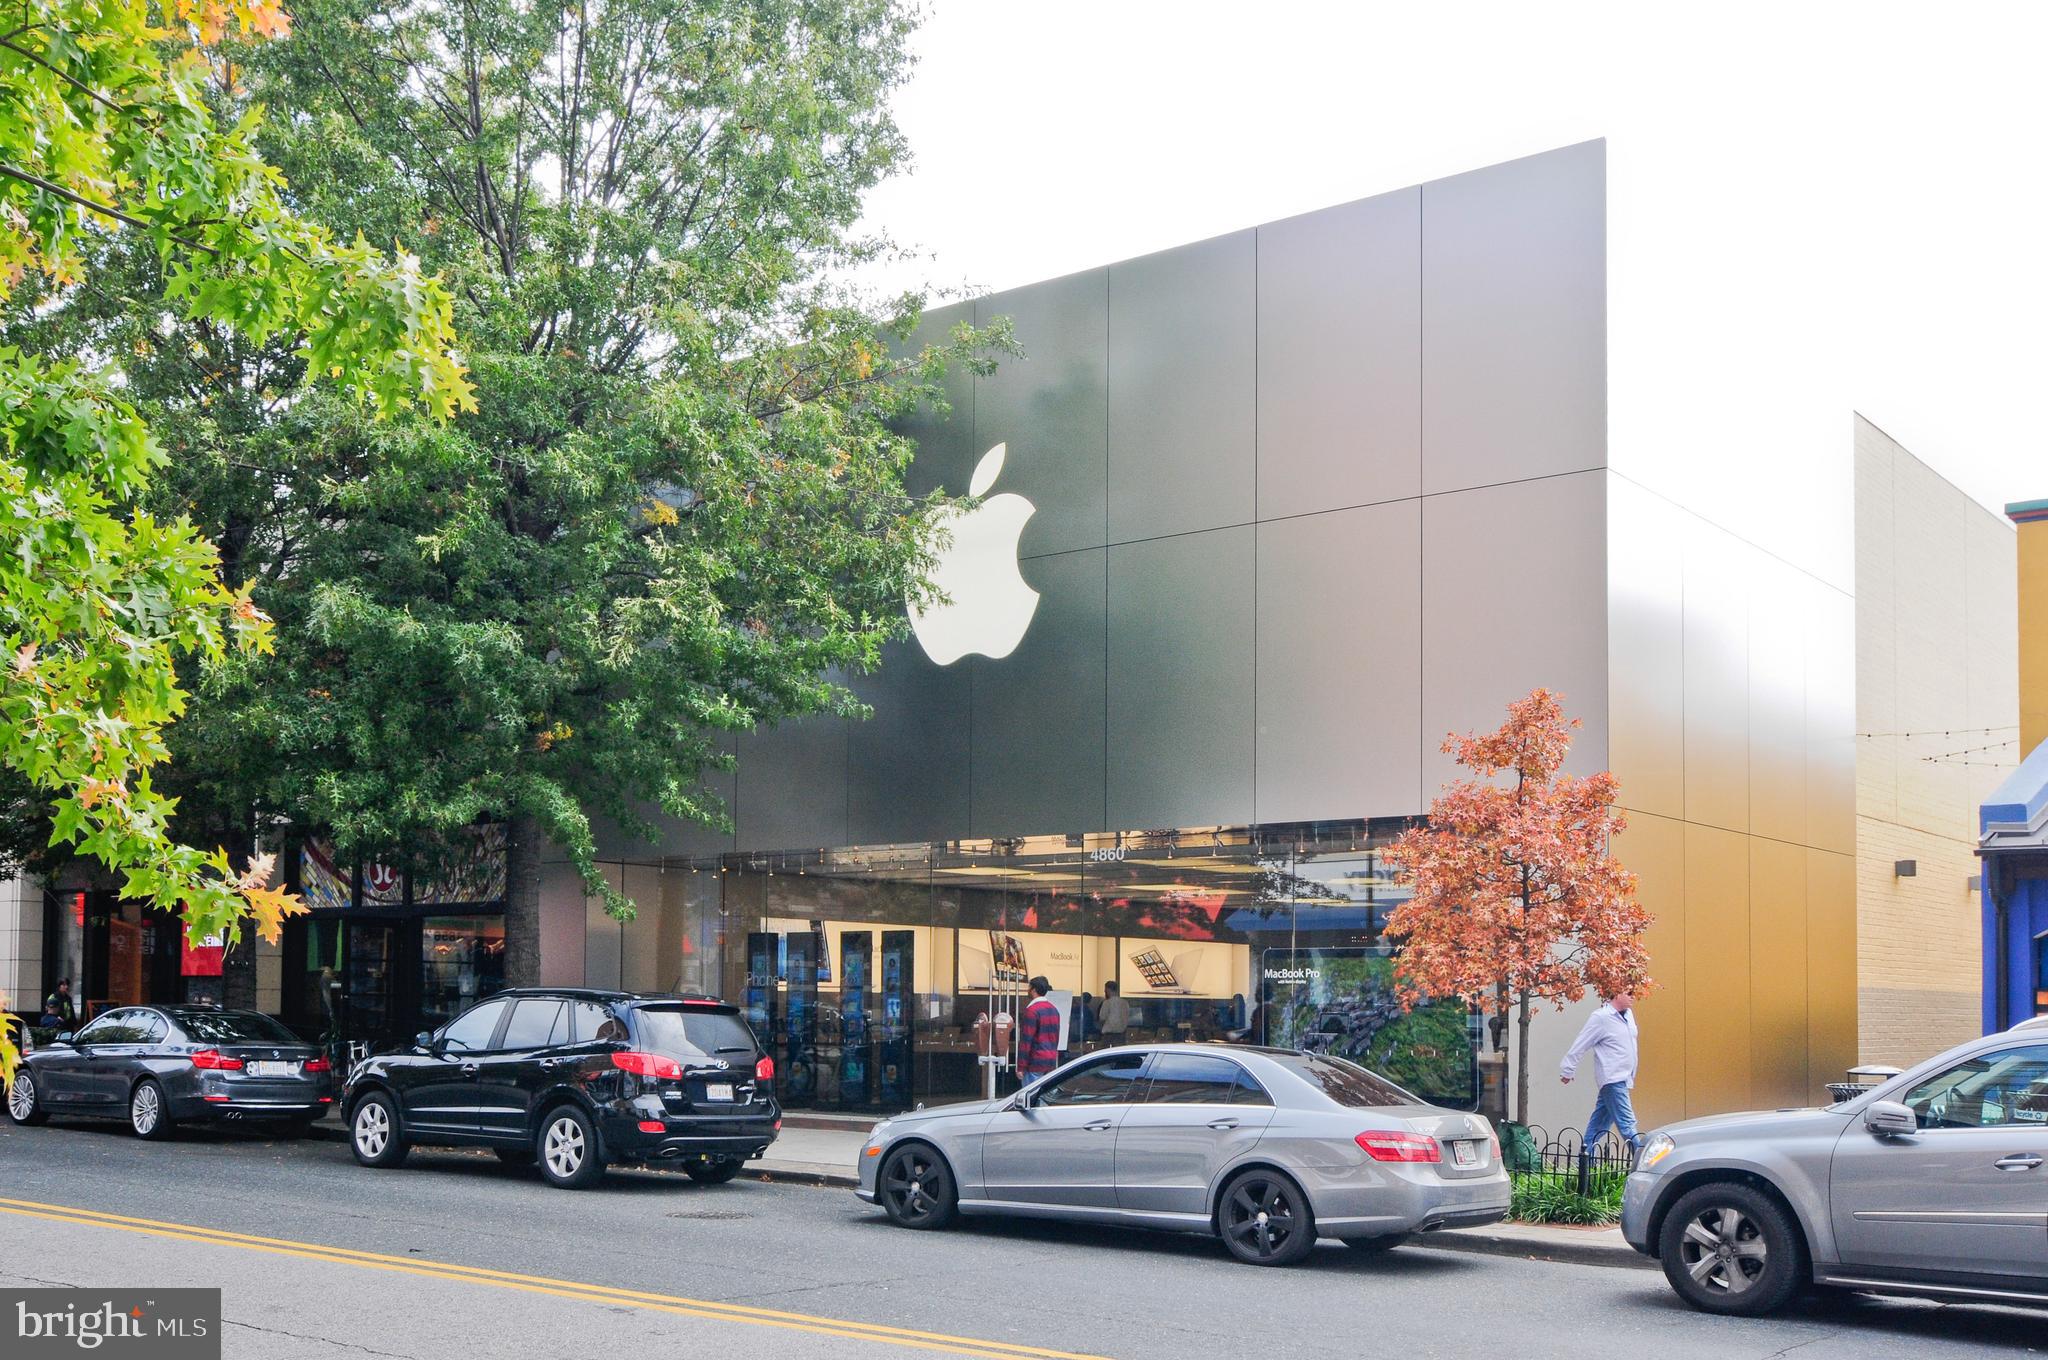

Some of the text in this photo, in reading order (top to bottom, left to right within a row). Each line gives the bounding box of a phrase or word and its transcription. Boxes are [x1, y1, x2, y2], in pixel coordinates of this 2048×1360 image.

[1090, 847, 1125, 861] 4860
[744, 972, 779, 987] iPhone
[1264, 968, 1320, 979] MacBook Pro
